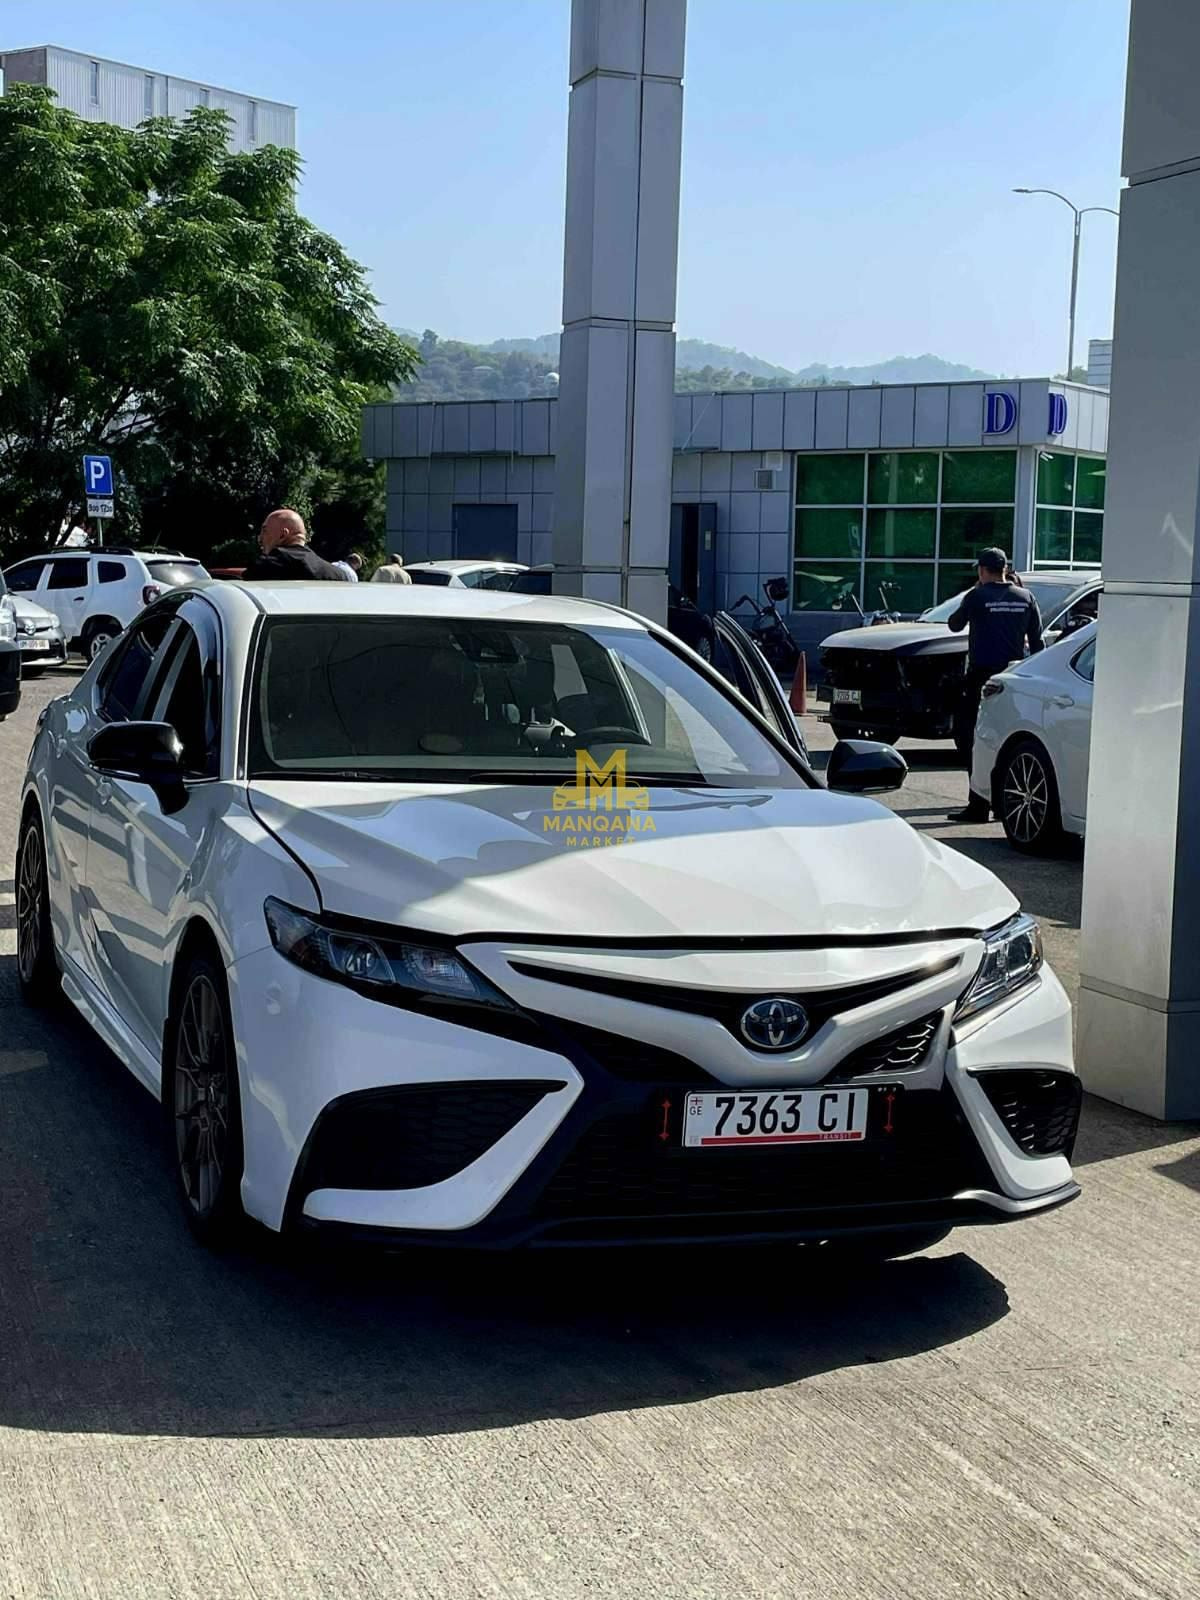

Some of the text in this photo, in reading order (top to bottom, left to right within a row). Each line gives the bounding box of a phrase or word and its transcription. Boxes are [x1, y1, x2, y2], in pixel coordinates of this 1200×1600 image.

[982, 392, 1017, 435] D
[1048, 393, 1067, 435] D
[90, 461, 105, 489] P
[690, 1106, 702, 1115] GE
[714, 1092, 855, 1136] 7363 CI
[819, 1132, 852, 1140] TRANSIT
